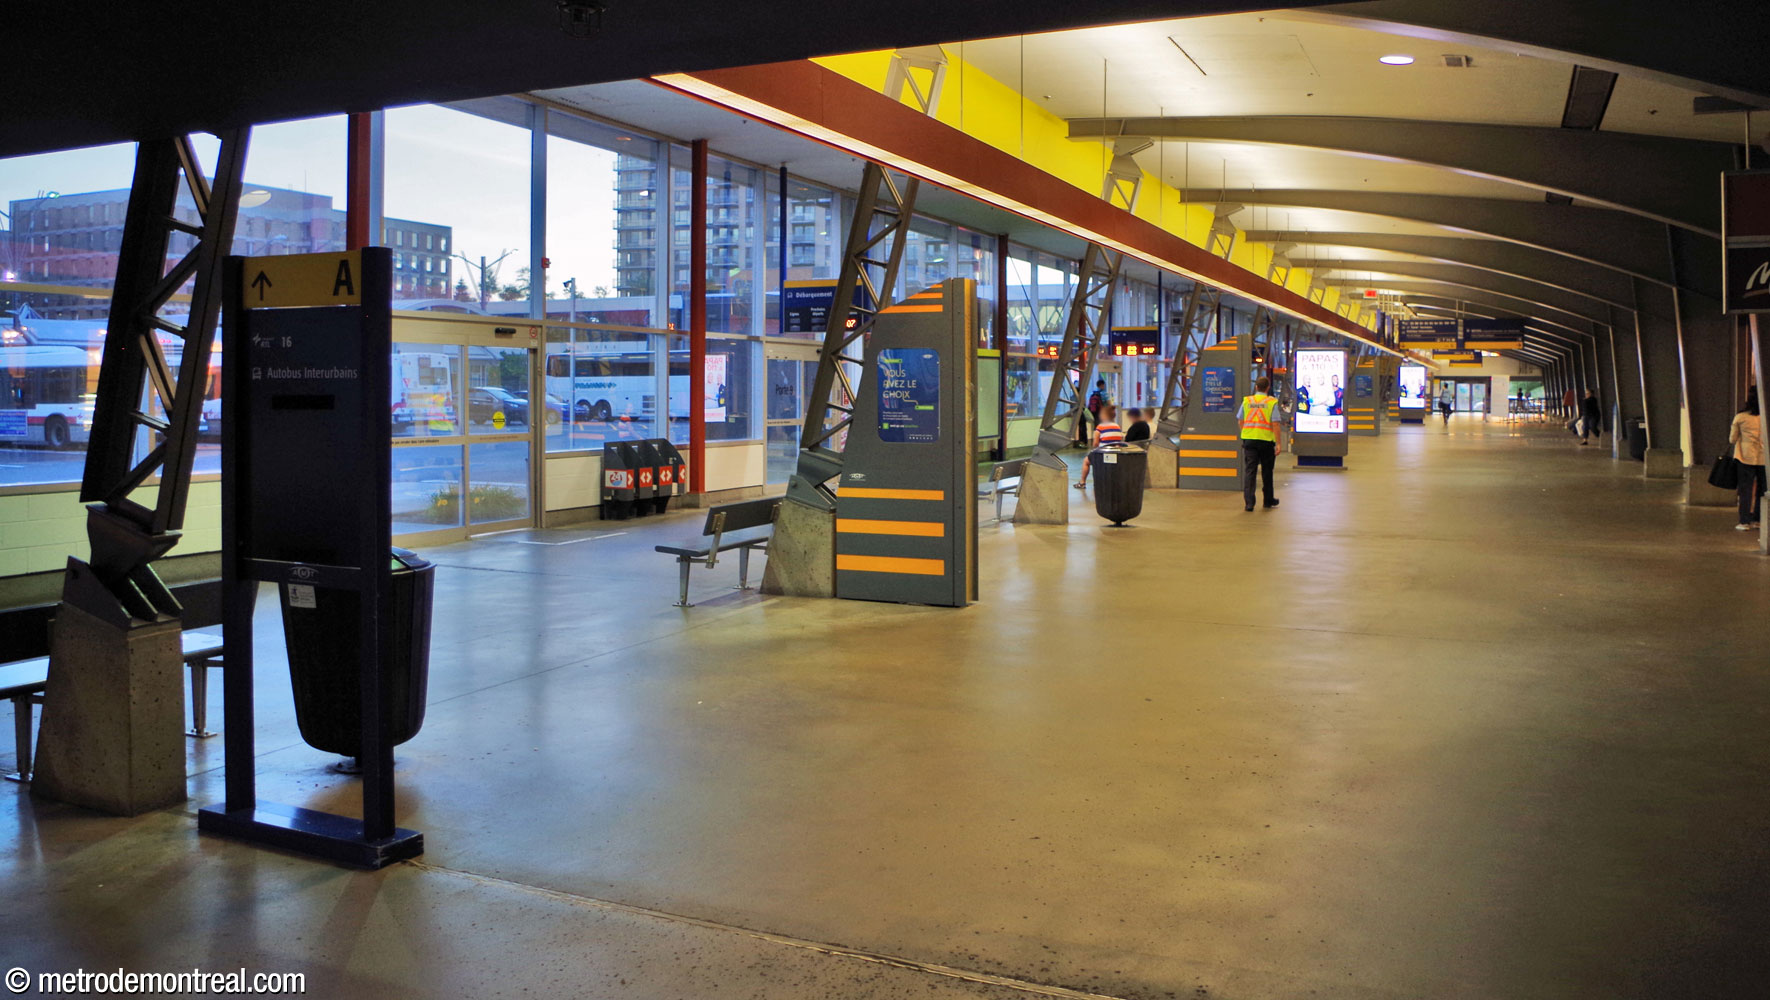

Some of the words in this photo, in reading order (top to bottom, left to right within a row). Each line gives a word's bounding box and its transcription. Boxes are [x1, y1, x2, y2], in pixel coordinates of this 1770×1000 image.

[333, 259, 354, 296] A
[281, 336, 293, 348] 16
[267, 367, 301, 379] Autobus
[304, 366, 358, 379] Interurbains
[884, 369, 906, 377] VOUS
[776, 384, 789, 395] Porte
[883, 380, 905, 388] AVEZ
[907, 380, 917, 388] LE
